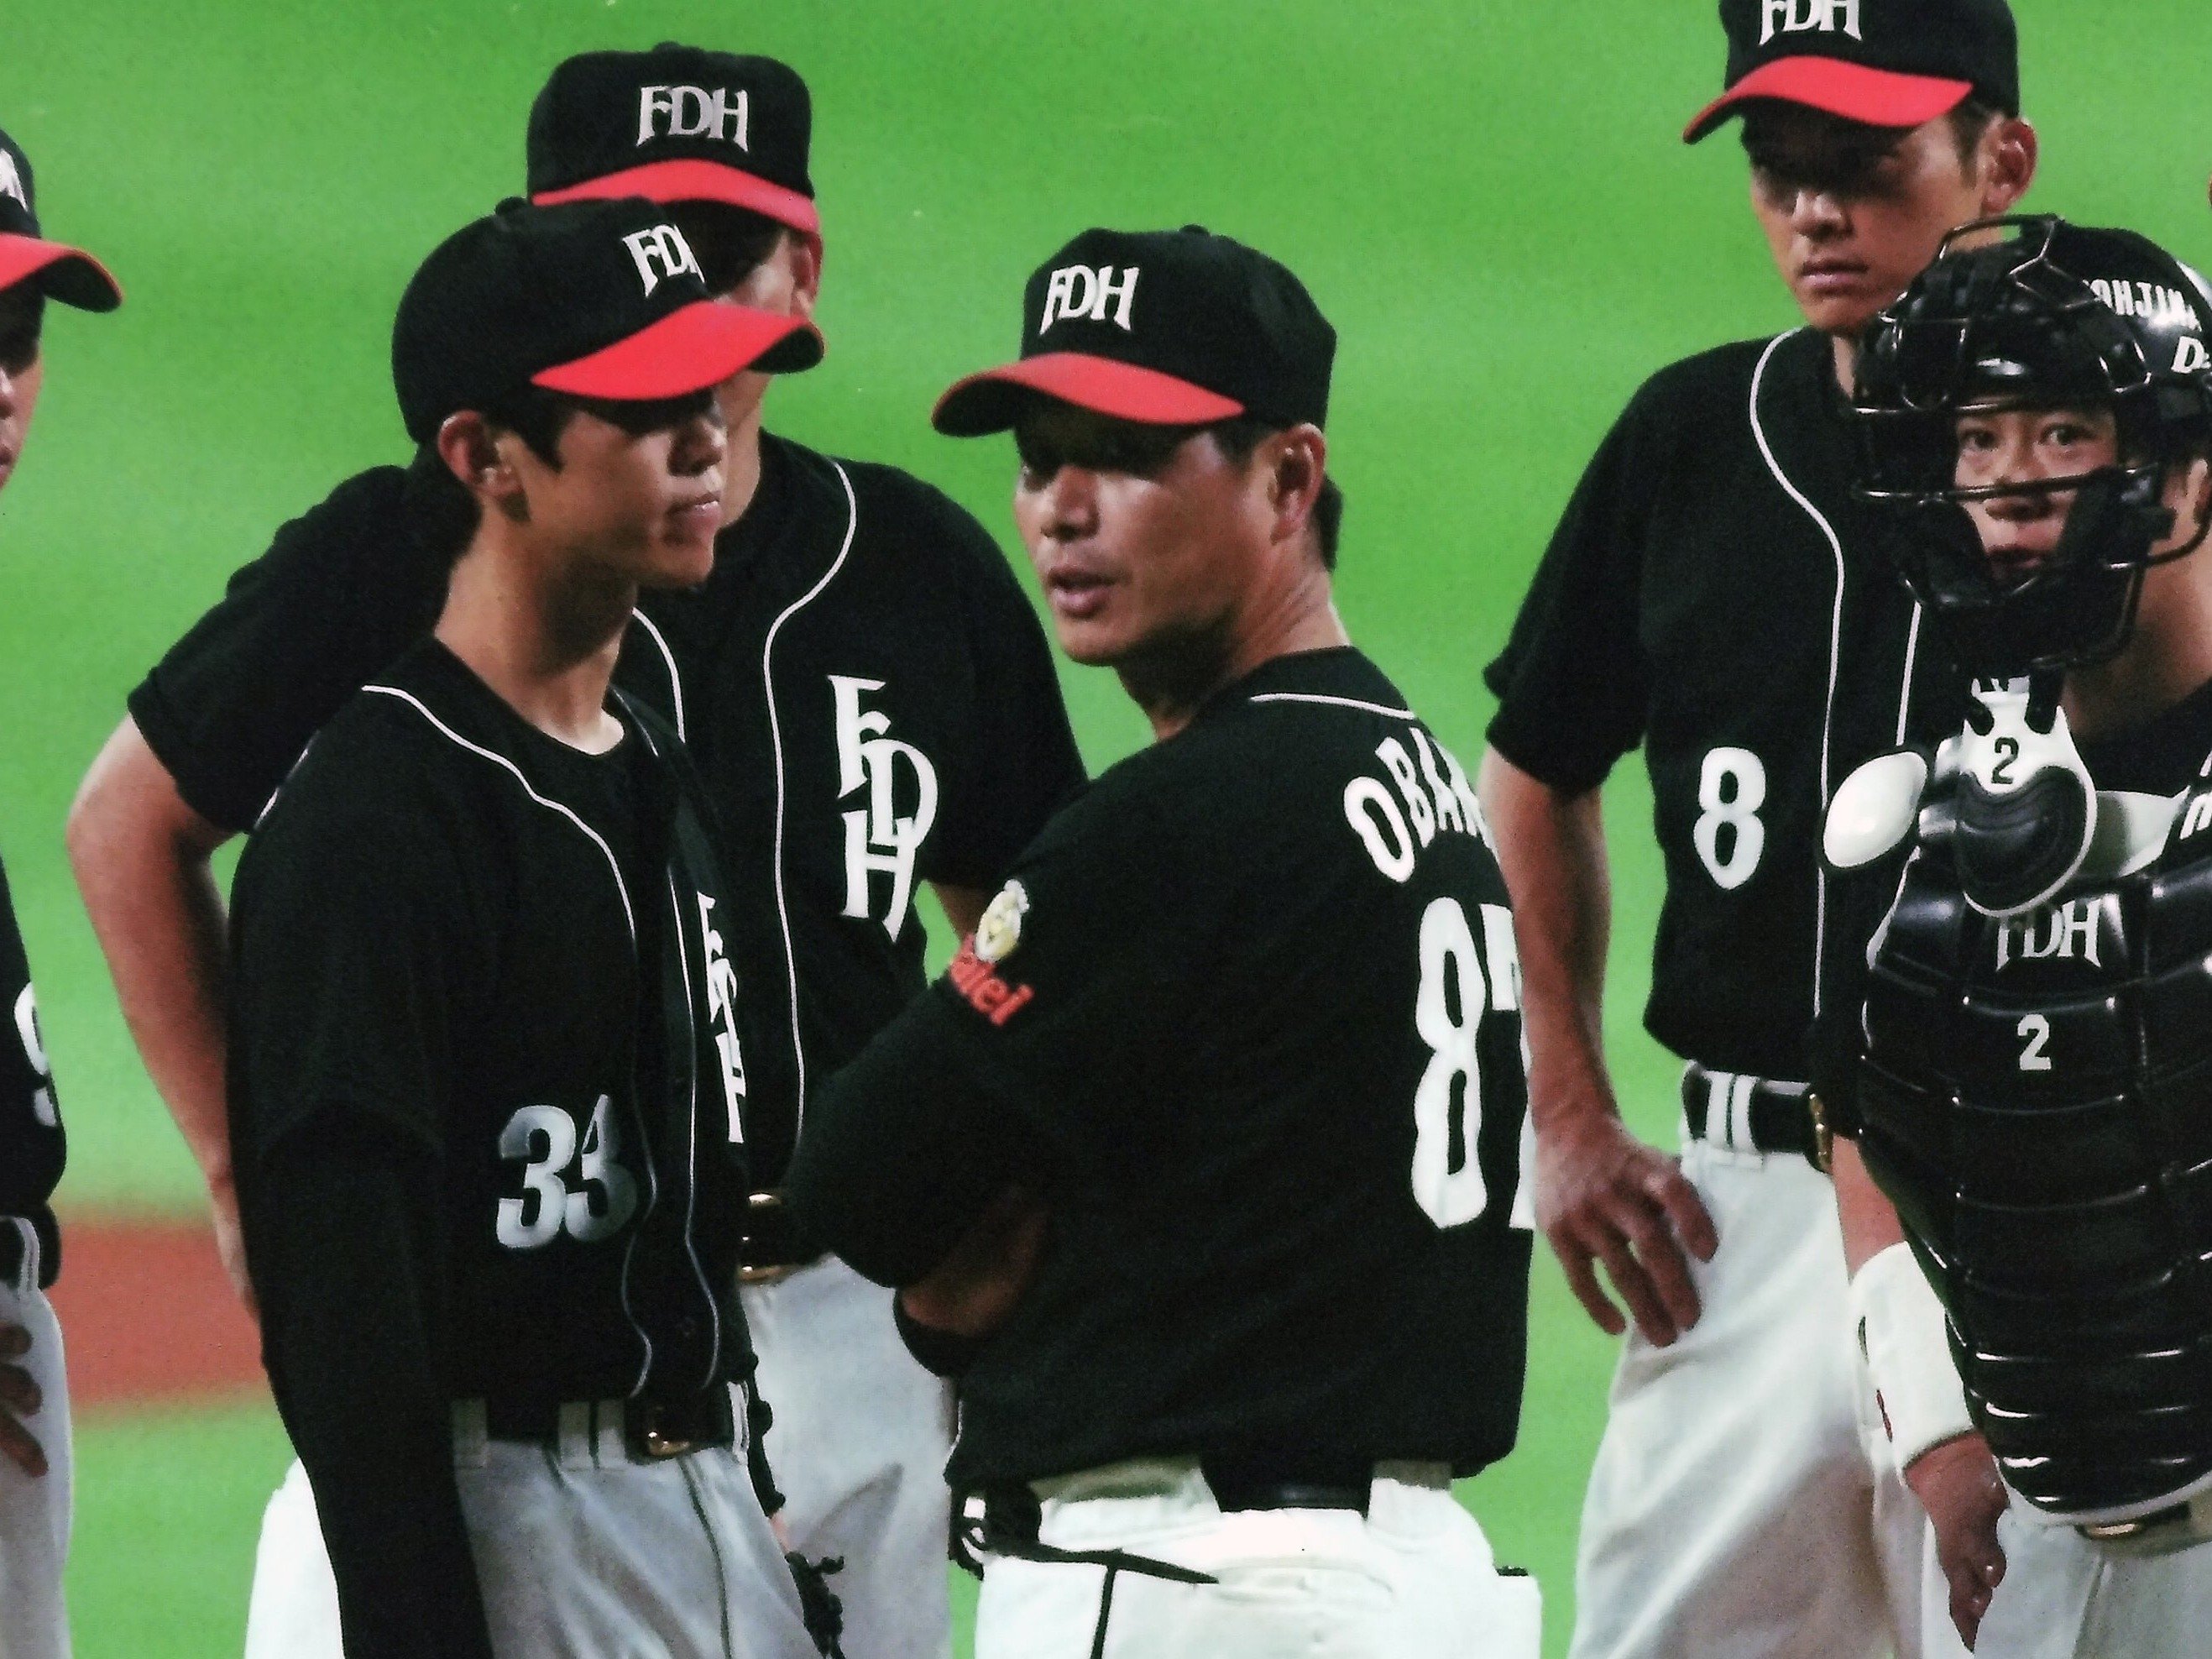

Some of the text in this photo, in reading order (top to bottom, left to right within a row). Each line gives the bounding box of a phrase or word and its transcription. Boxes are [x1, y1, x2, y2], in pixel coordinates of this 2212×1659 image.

[1759, 0, 1862, 45] FDH
[636, 86, 749, 152] FDH
[1039, 264, 1140, 335] FDH
[1991, 737, 2020, 785] 2
[1693, 746, 1766, 890] 8
[2018, 1013, 2053, 1070] 2
